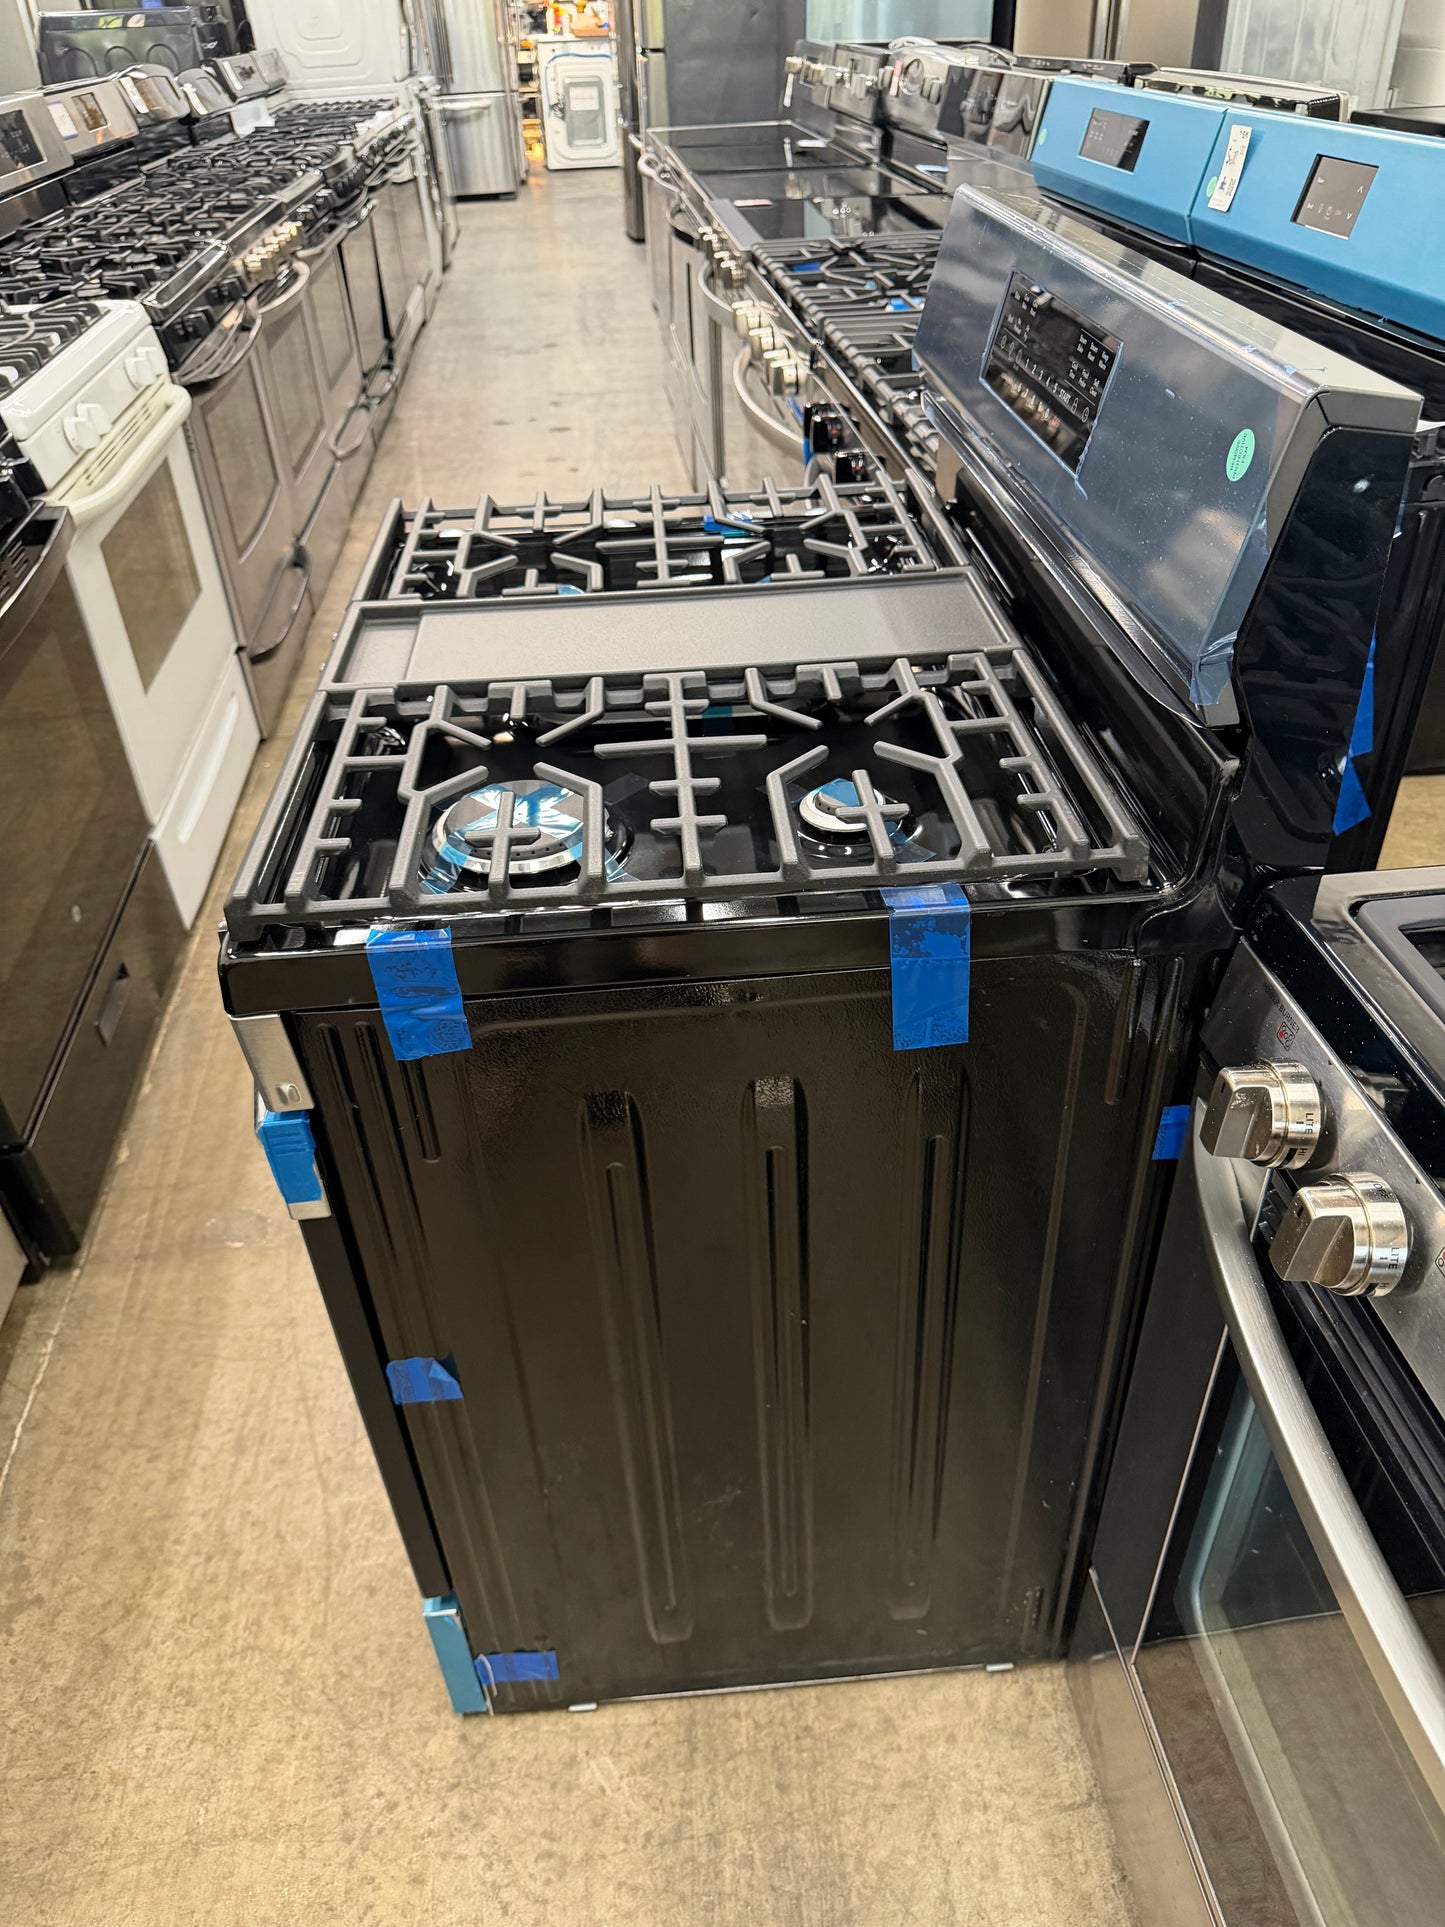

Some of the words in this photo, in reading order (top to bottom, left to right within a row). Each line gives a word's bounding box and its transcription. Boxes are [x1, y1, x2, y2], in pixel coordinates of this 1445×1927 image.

[1031, 364, 1037, 375] 2
[1052, 383, 1058, 393] 5
[1059, 389, 1072, 404] START
[1279, 1003, 1300, 1034] BURNER
[1305, 1112, 1314, 1135] LITE
[1297, 1147, 1308, 1156] HI
[1373, 1183, 1390, 1199] OFF
[1389, 1247, 1400, 1270] LITE
[1377, 1282, 1390, 1290] HI
